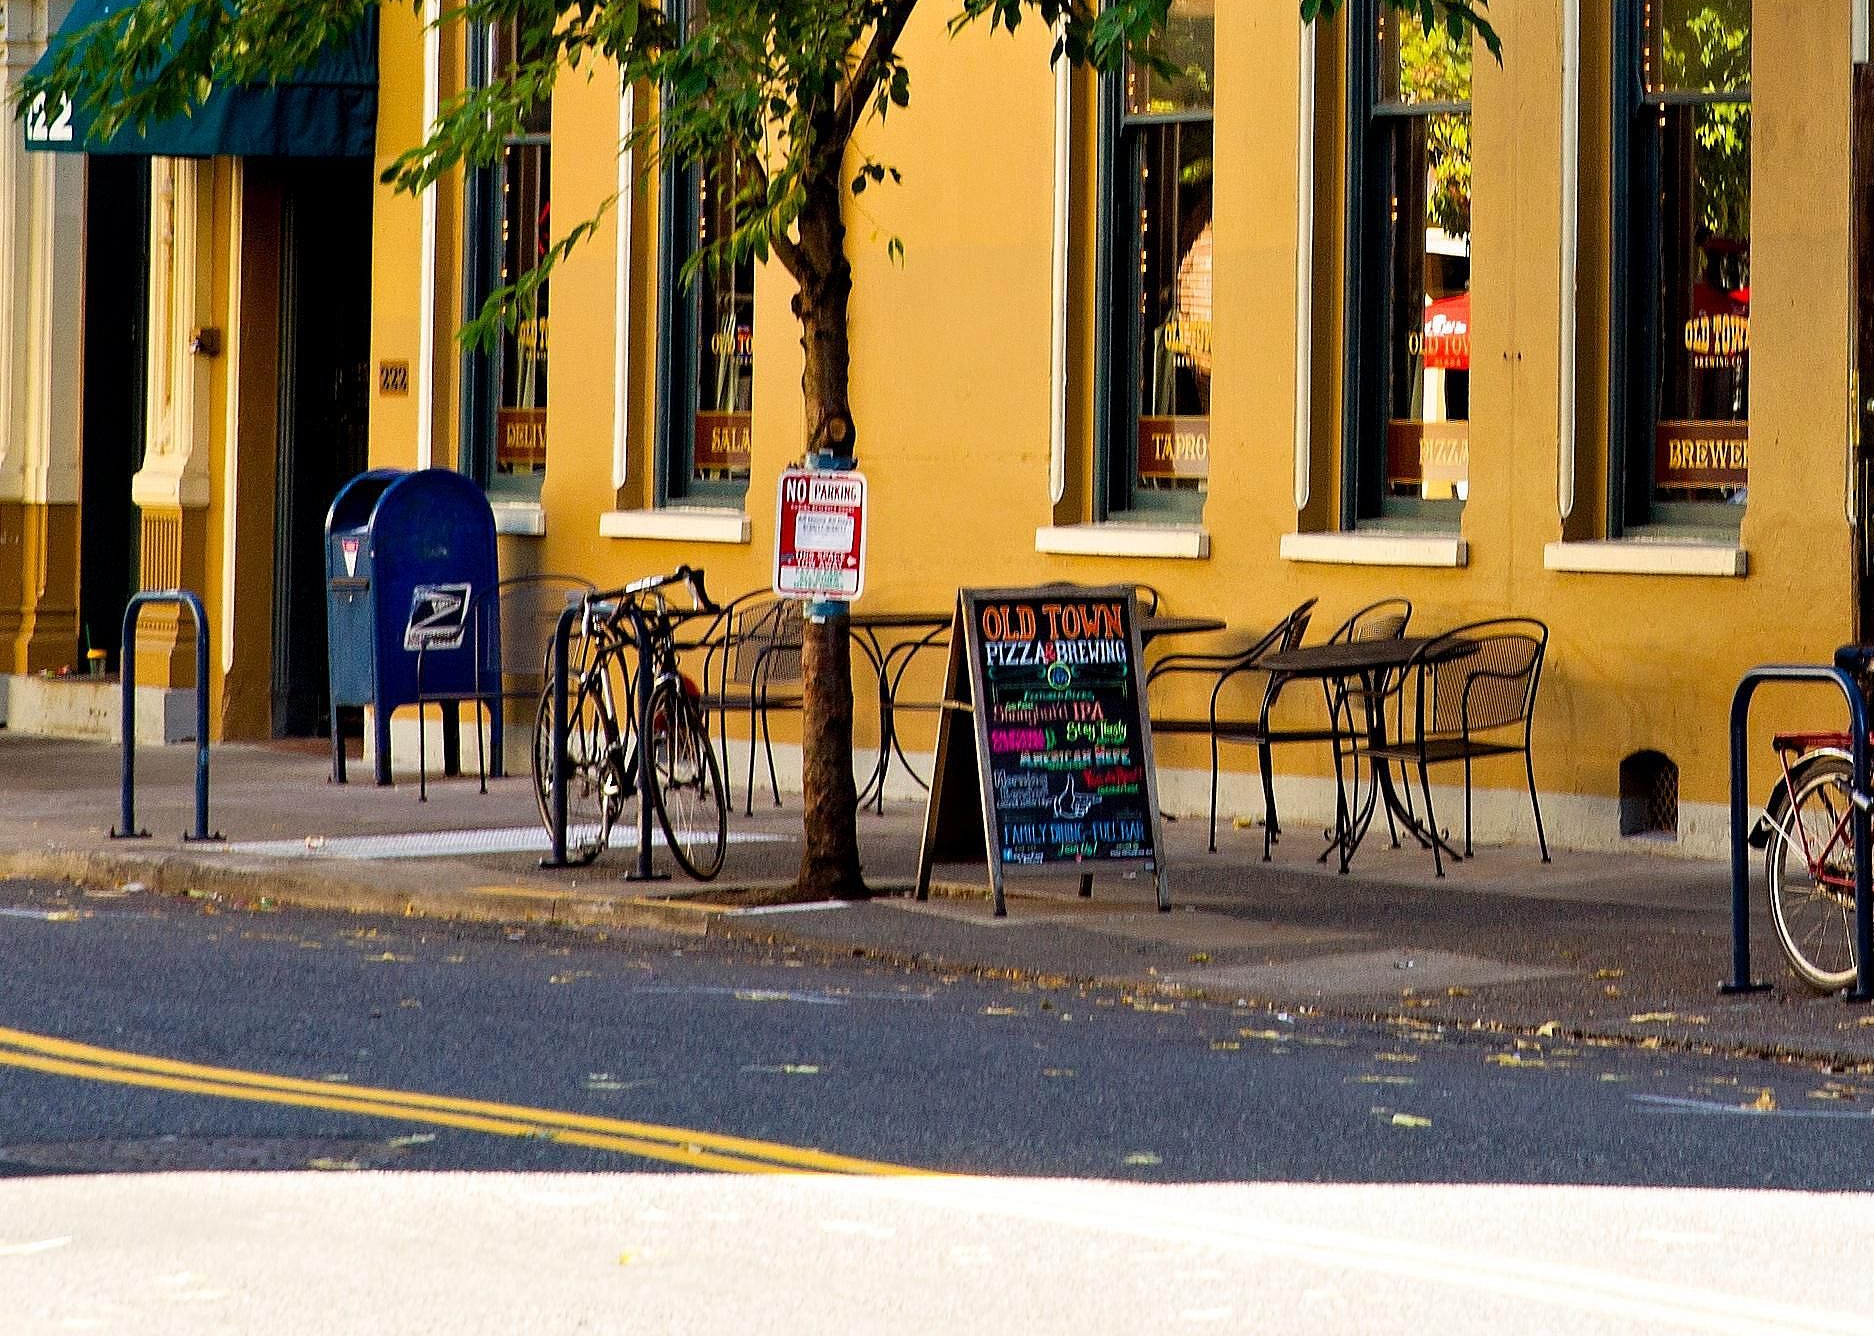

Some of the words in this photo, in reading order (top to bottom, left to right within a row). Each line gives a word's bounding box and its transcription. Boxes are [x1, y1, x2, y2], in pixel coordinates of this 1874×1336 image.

[1684, 317, 1709, 355] OLD
[380, 366, 407, 391] 222
[786, 477, 807, 504] NO
[814, 482, 857, 505] PARKING
[982, 604, 1036, 641] OLD
[1042, 603, 1125, 641] TOWN
[985, 639, 1046, 666] PIZZA
[1055, 639, 1127, 665] BREWING
[1073, 700, 1105, 722] IPA
[1003, 823, 1047, 845] FAMILY
